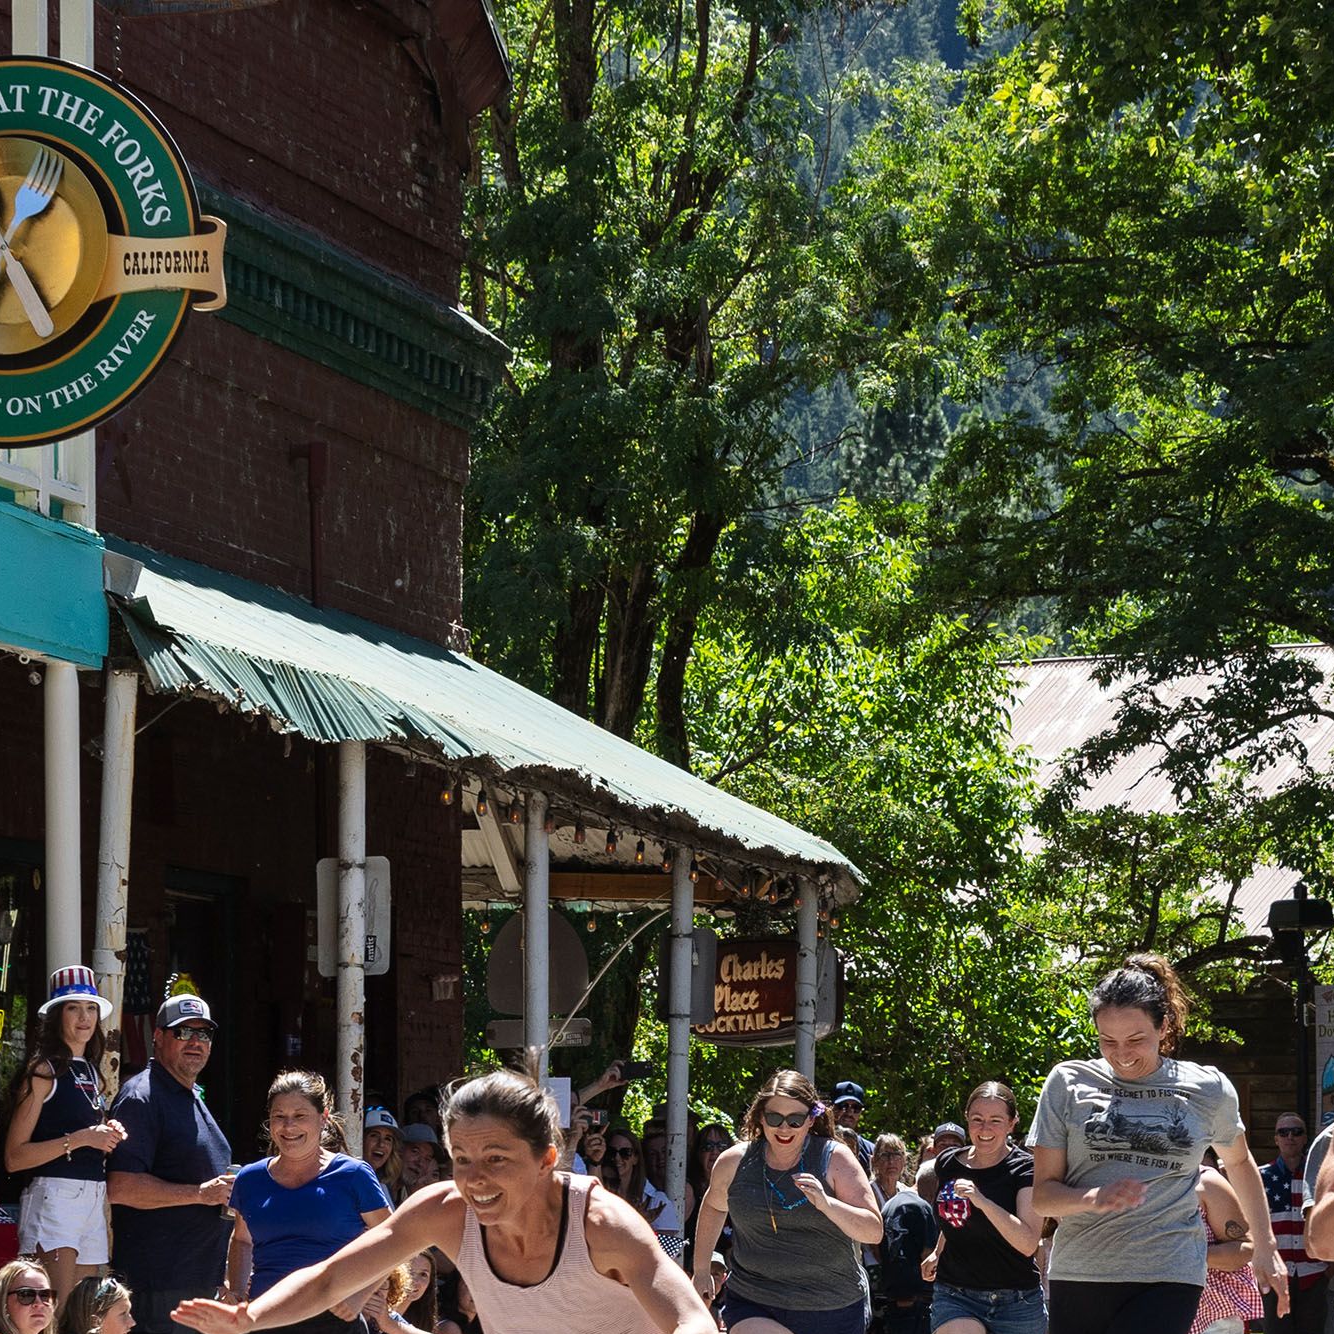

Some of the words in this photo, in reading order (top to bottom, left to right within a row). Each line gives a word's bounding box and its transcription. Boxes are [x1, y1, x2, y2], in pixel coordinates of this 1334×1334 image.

[37, 86, 104, 133] THE
[99, 119, 172, 227] FORKS
[123, 250, 210, 276] CALIFORNIA
[5, 394, 42, 416] ON
[45, 373, 98, 410] THE
[95, 308, 157, 380] RIVER
[720, 950, 785, 983] Charles
[714, 983, 759, 1013] Place
[1114, 1088, 1143, 1099] SECRET
[1147, 1089, 1156, 1098] TO
[1089, 1153, 1106, 1161] FISH
[1108, 1153, 1133, 1164] WHERE
[1136, 1155, 1148, 1166] THE
[1151, 1158, 1167, 1168] FISH
